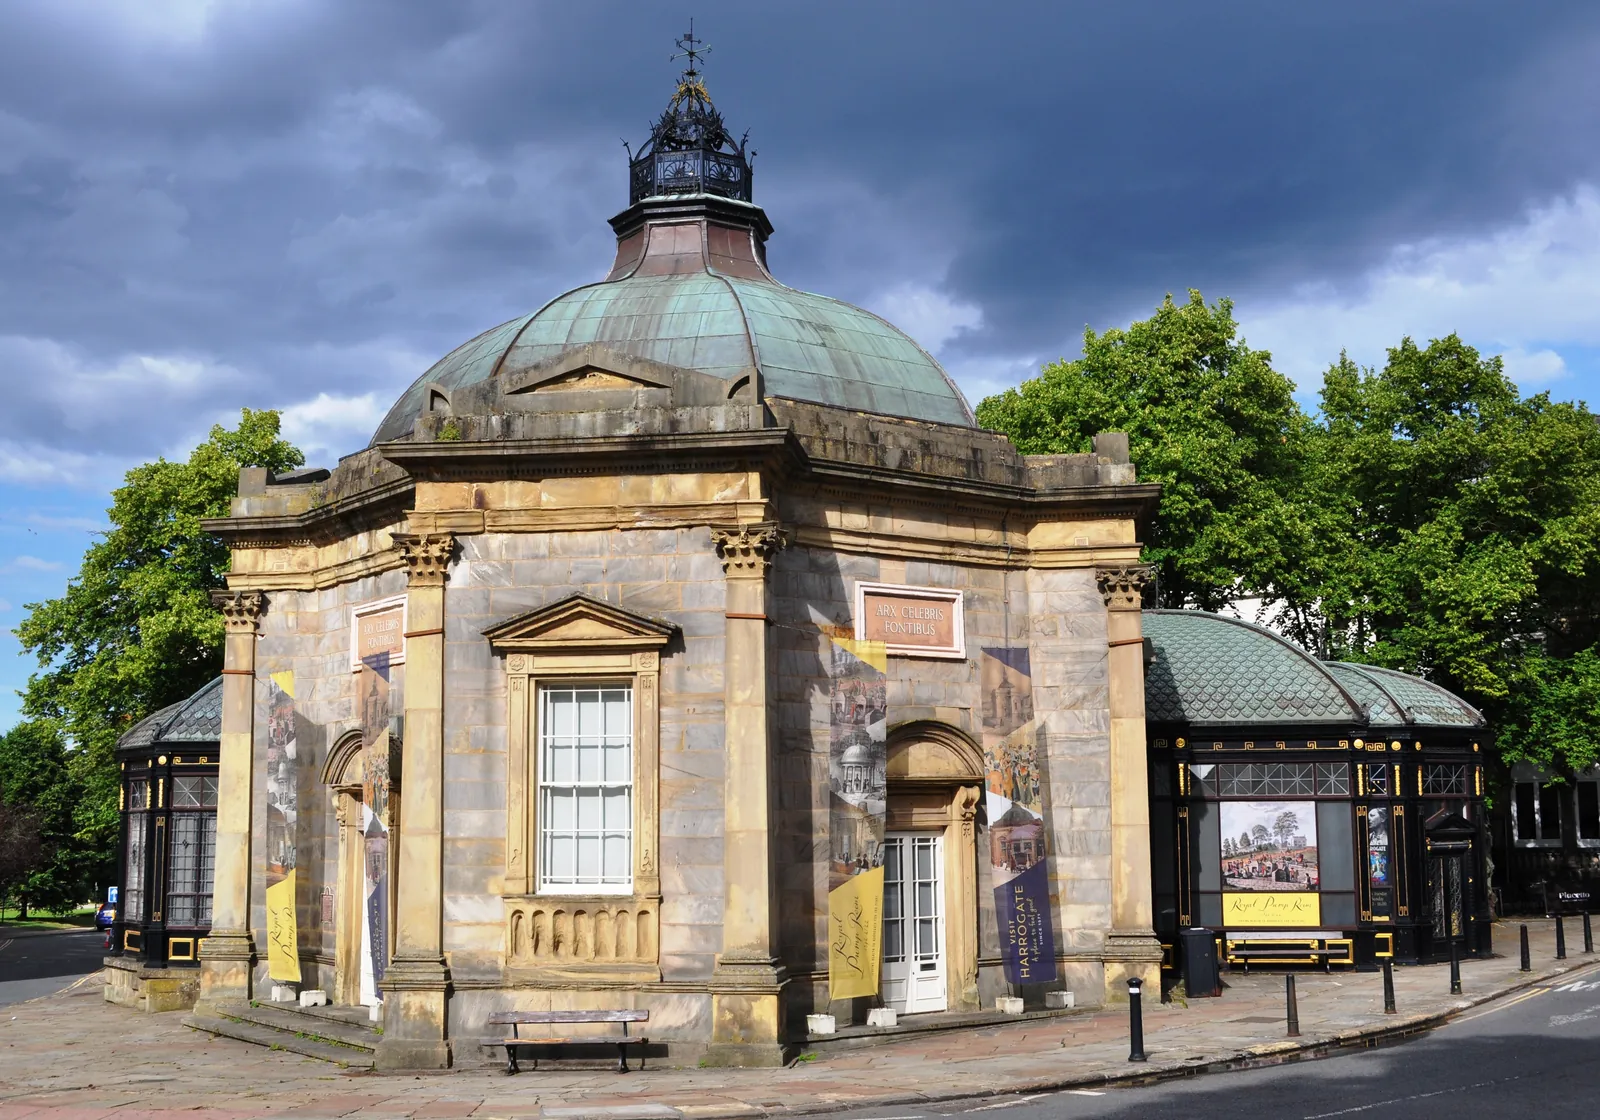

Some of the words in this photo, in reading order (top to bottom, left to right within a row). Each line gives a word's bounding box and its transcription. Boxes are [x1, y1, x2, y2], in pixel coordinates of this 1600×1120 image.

[876, 604, 897, 617] ARX
[901, 606, 944, 620] CELEBRIS
[885, 620, 936, 635] FONTIBUS
[847, 896, 864, 930] Room
[1026, 897, 1038, 913] good
[1229, 897, 1260, 913] Royal
[1258, 895, 1289, 912] Pump
[268, 906, 284, 946] Royal
[1008, 920, 1016, 945] VISIT
[1014, 885, 1030, 978] HARROGATE
[1028, 914, 1037, 927] feel
[280, 925, 296, 967] Pump
[832, 912, 851, 959] Royal
[1030, 939, 1041, 955] place
[846, 932, 864, 980] Pump
